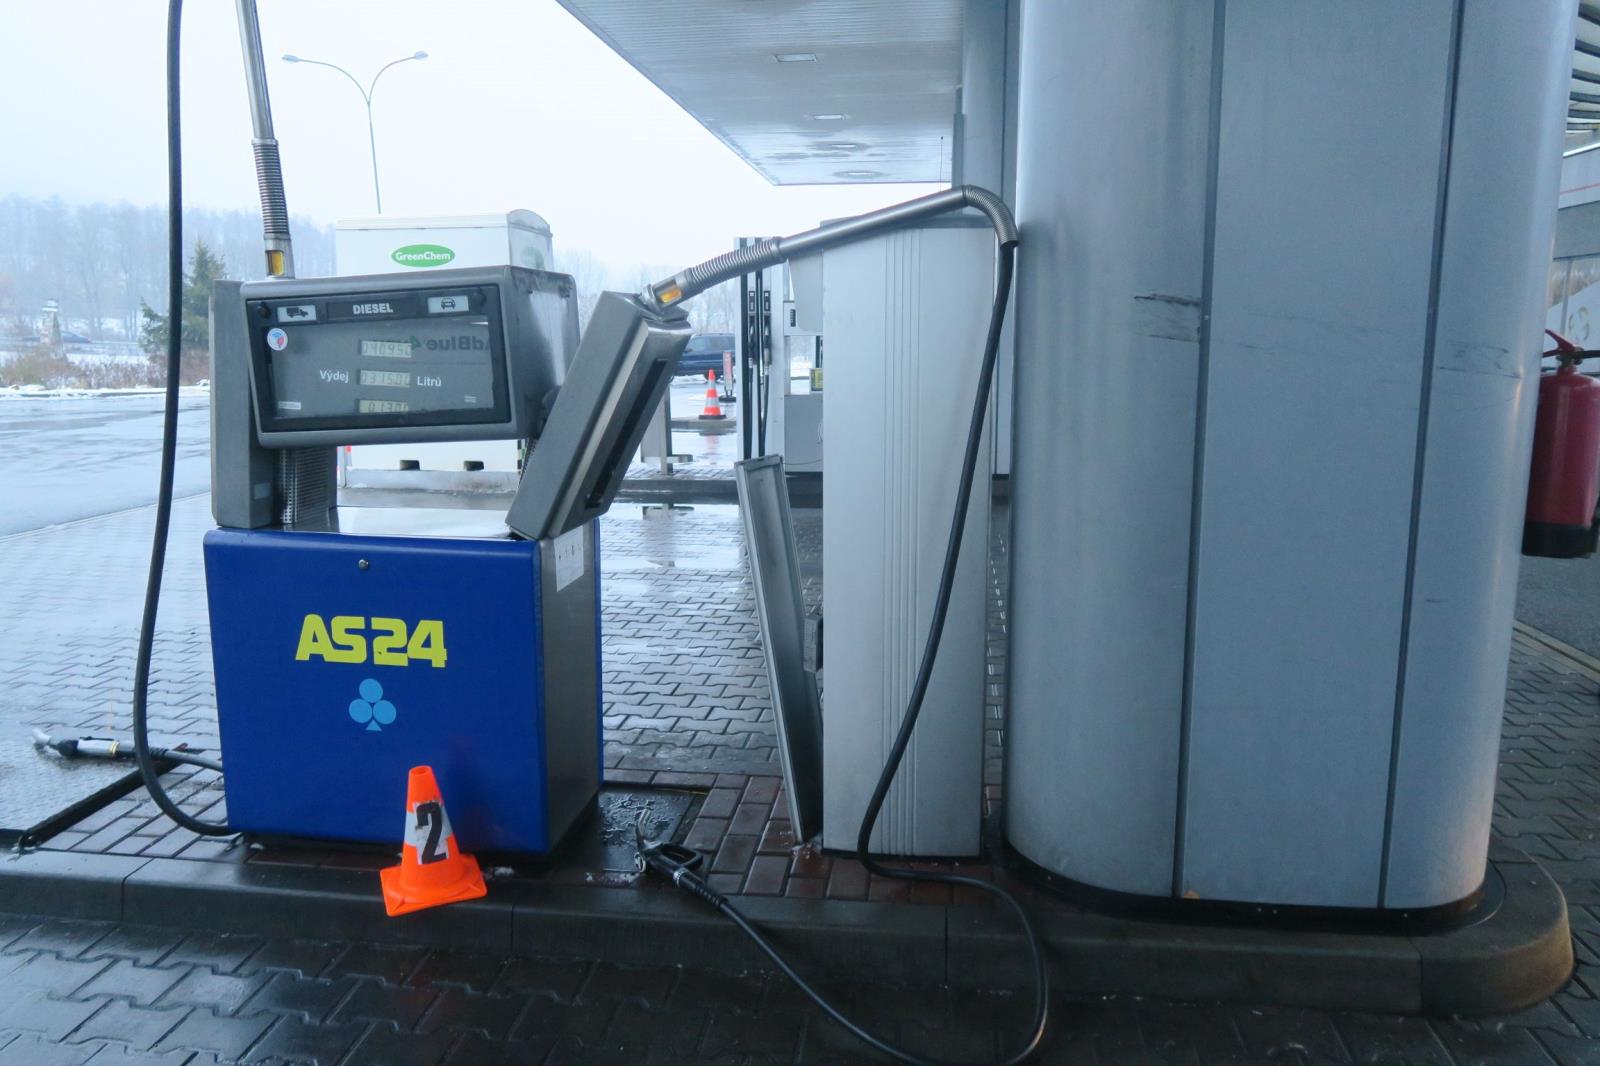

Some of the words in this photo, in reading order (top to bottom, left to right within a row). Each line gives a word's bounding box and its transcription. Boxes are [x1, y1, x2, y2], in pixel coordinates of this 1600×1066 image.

[395, 251, 451, 261] GreenChem
[352, 303, 394, 315] DIESEL
[319, 369, 349, 384] Výdej
[416, 376, 442, 387] Litrů
[415, 801, 447, 865] 2
